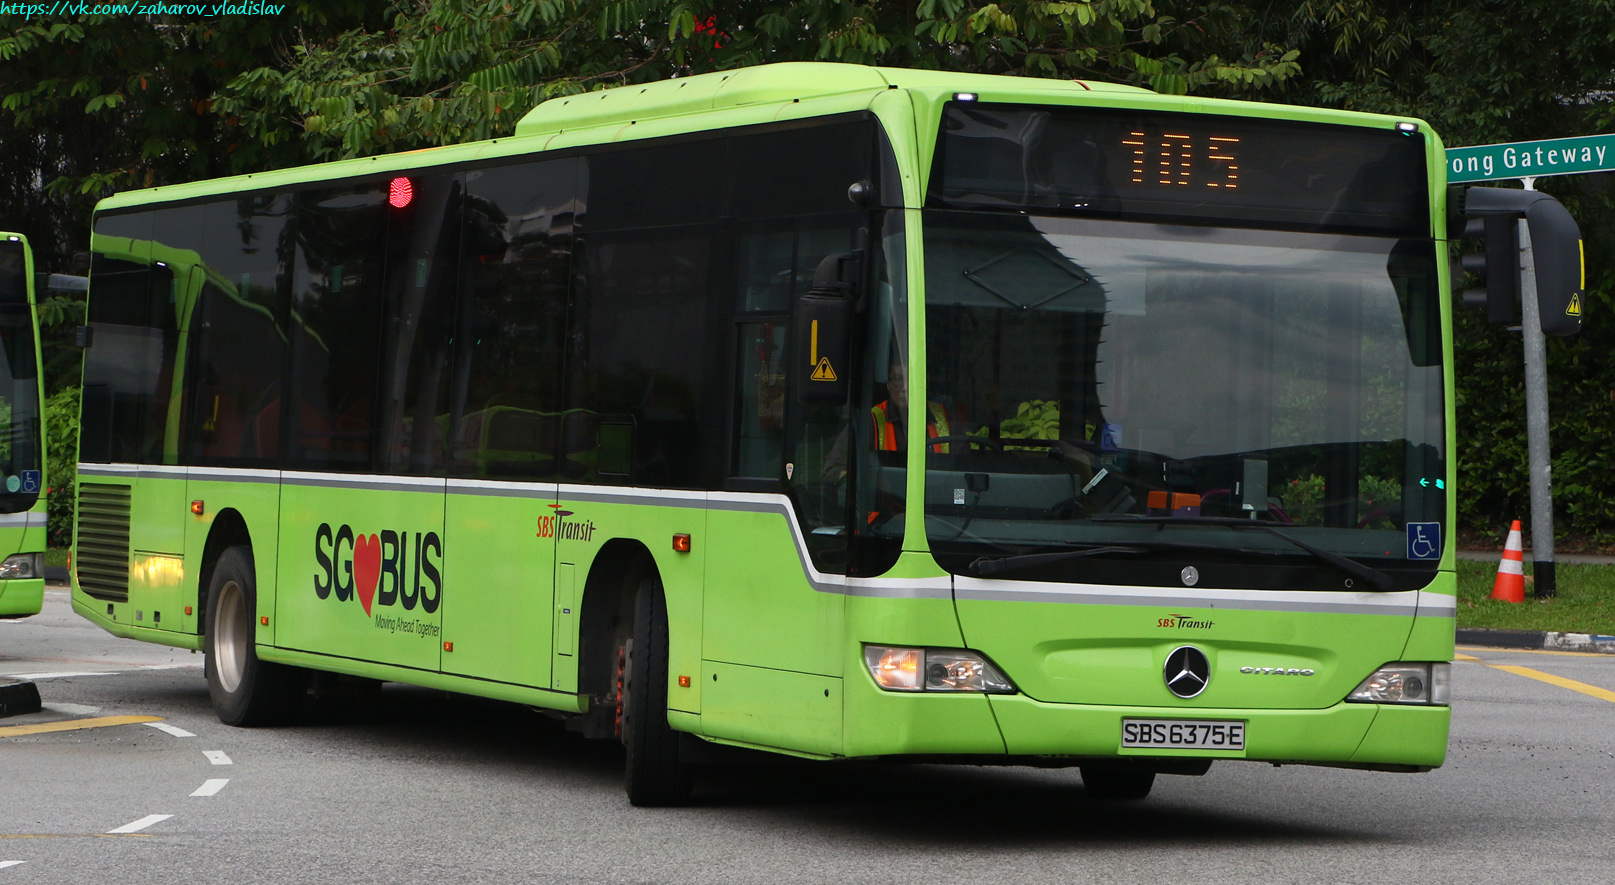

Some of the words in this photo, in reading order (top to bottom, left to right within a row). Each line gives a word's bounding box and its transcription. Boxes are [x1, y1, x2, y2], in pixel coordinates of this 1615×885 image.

[1121, 132, 1240, 188] 105
[1446, 155, 1493, 176] ong
[1503, 145, 1606, 169] Gateway
[536, 515, 555, 538] SBS
[554, 510, 596, 544] Transit
[378, 529, 442, 614] BUS
[375, 614, 395, 634] Moving
[396, 617, 414, 633] Ahead
[415, 619, 440, 638] Together
[1157, 618, 1175, 628] SBS
[1174, 616, 1215, 629] Transit
[1240, 667, 1316, 677] CITARO
